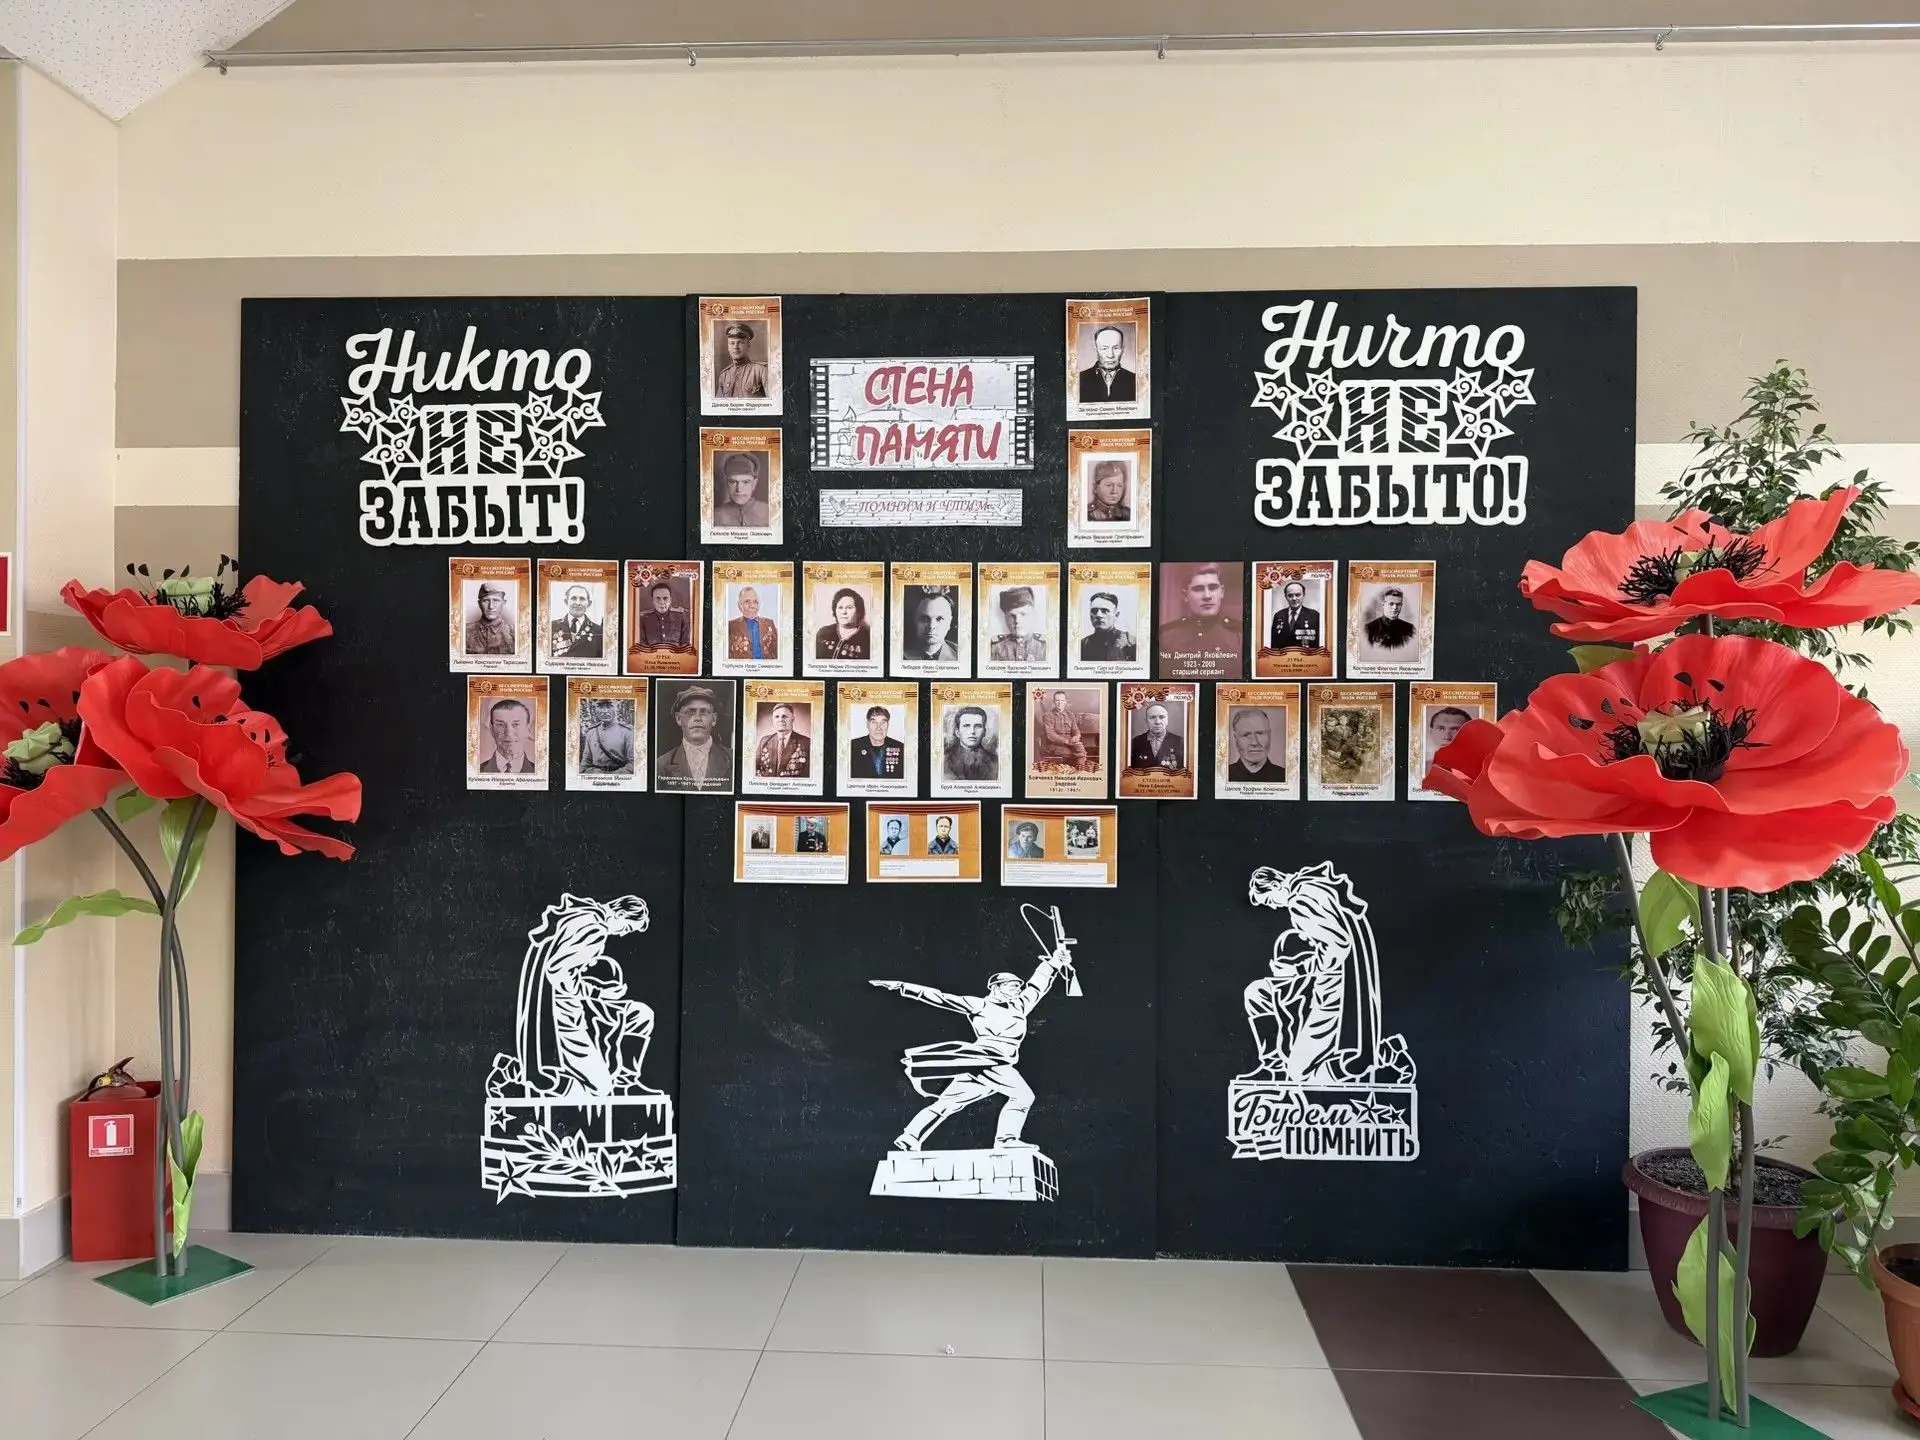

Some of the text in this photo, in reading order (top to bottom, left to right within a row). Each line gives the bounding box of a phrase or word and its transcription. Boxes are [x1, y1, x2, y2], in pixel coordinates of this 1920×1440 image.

[345, 326, 592, 395] Никто
[1261, 300, 1526, 370] Ничто
[865, 365, 974, 407] СТЕНА
[422, 405, 522, 477] НЕ
[856, 422, 1002, 466] ПАМЯТИ
[1340, 381, 1446, 455] НЕ
[362, 480, 582, 543] ЗАБЫТ!
[858, 500, 923, 513] ПОМНИМ
[926, 500, 937, 512] И
[1258, 459, 1525, 523] ЗАБЫТО!
[1234, 1089, 1352, 1136] Будем
[1286, 1127, 1415, 1157] ПОМНИТЬ
